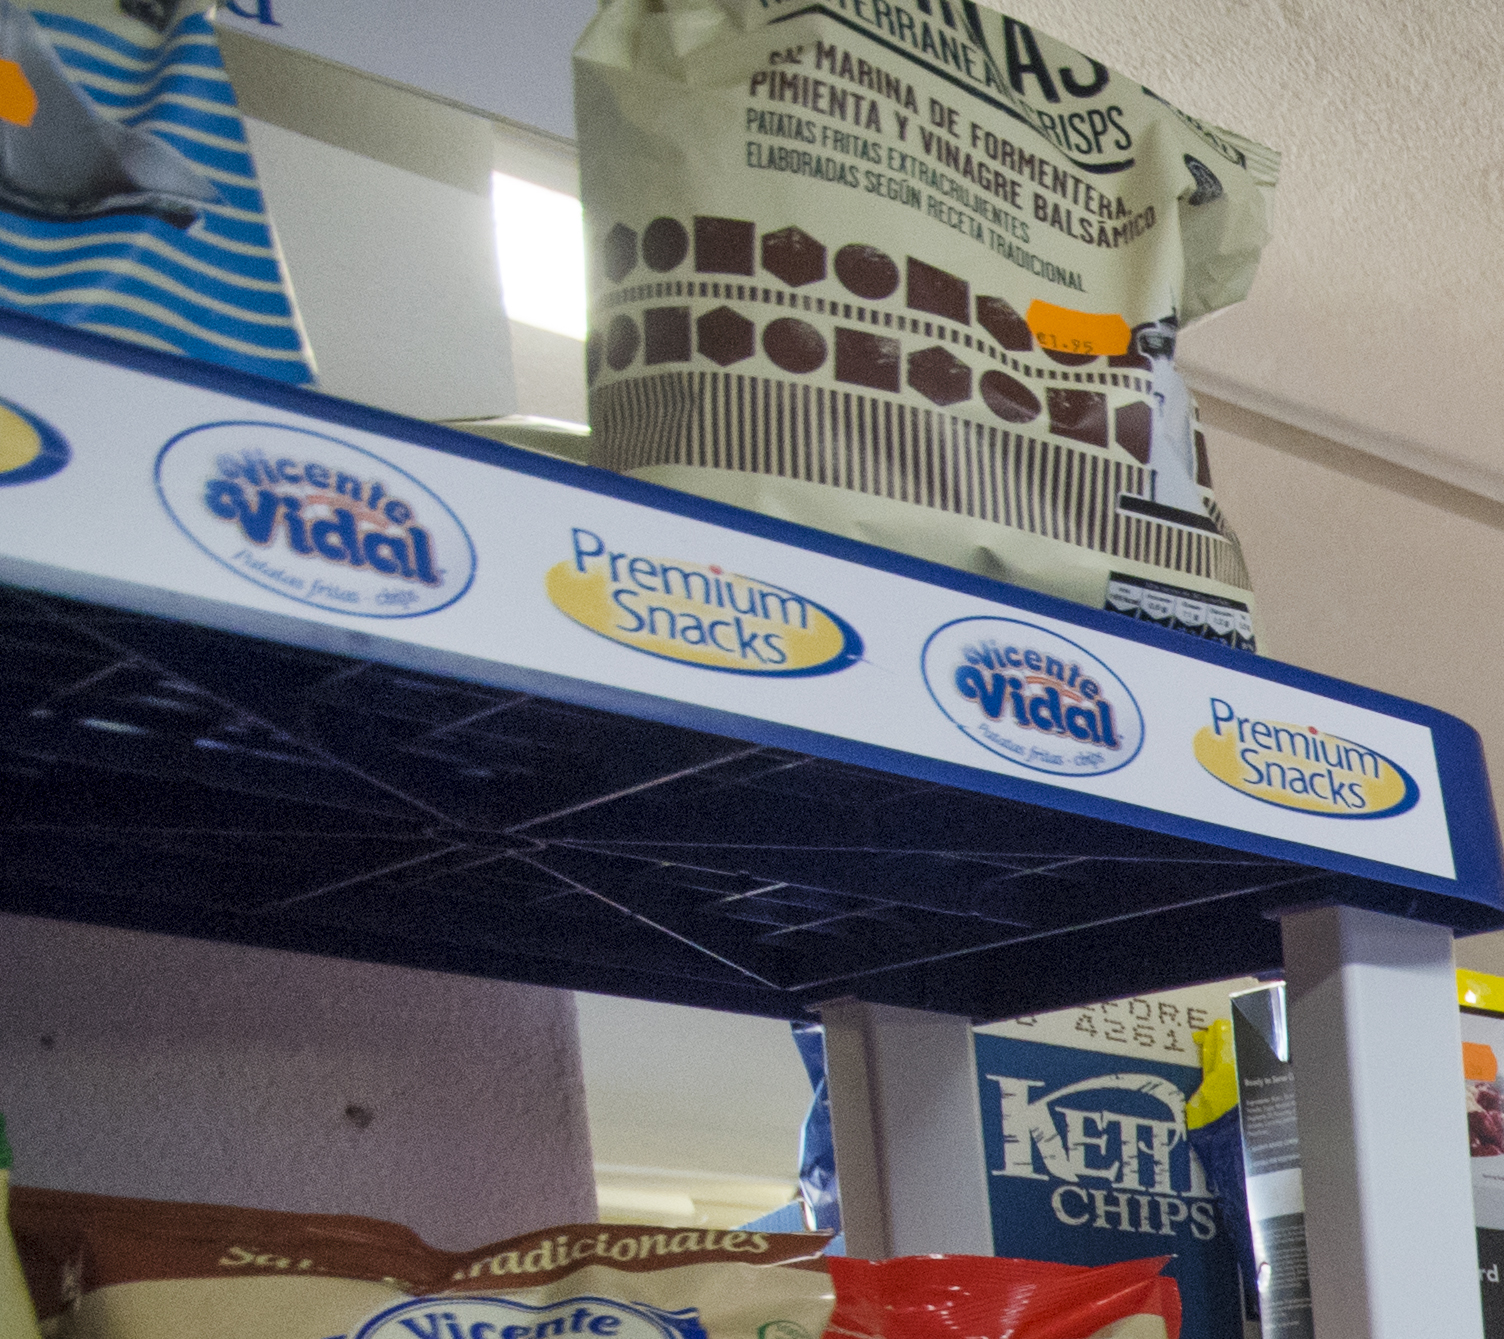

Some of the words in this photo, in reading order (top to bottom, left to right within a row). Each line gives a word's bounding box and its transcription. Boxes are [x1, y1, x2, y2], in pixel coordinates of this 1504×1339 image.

[746, 108, 818, 142] PATATAS
[821, 127, 882, 165] FRITAS
[749, 72, 883, 133] PIMIENTA
[894, 111, 909, 141] Y
[920, 127, 1024, 210] VINAGRE
[1033, 189, 1157, 249] BALSÁMICO
[815, 40, 919, 114] MARINA
[930, 98, 960, 137] DE
[971, 121, 1133, 219] FORMENTERA.
[746, 142, 860, 188] ELABORADAS
[864, 171, 922, 210] SEGÚN
[926, 198, 983, 243] RECETA
[988, 232, 1087, 293] TRADICIONAL
[205, 479, 440, 585] Vidal
[571, 527, 811, 633] Premium
[612, 584, 789, 668] Snacks
[955, 666, 1122, 750] Vidal
[1209, 697, 1382, 779] Premium
[1242, 748, 1366, 812] Snacks
[1052, 1185, 1216, 1240] CHIPS
